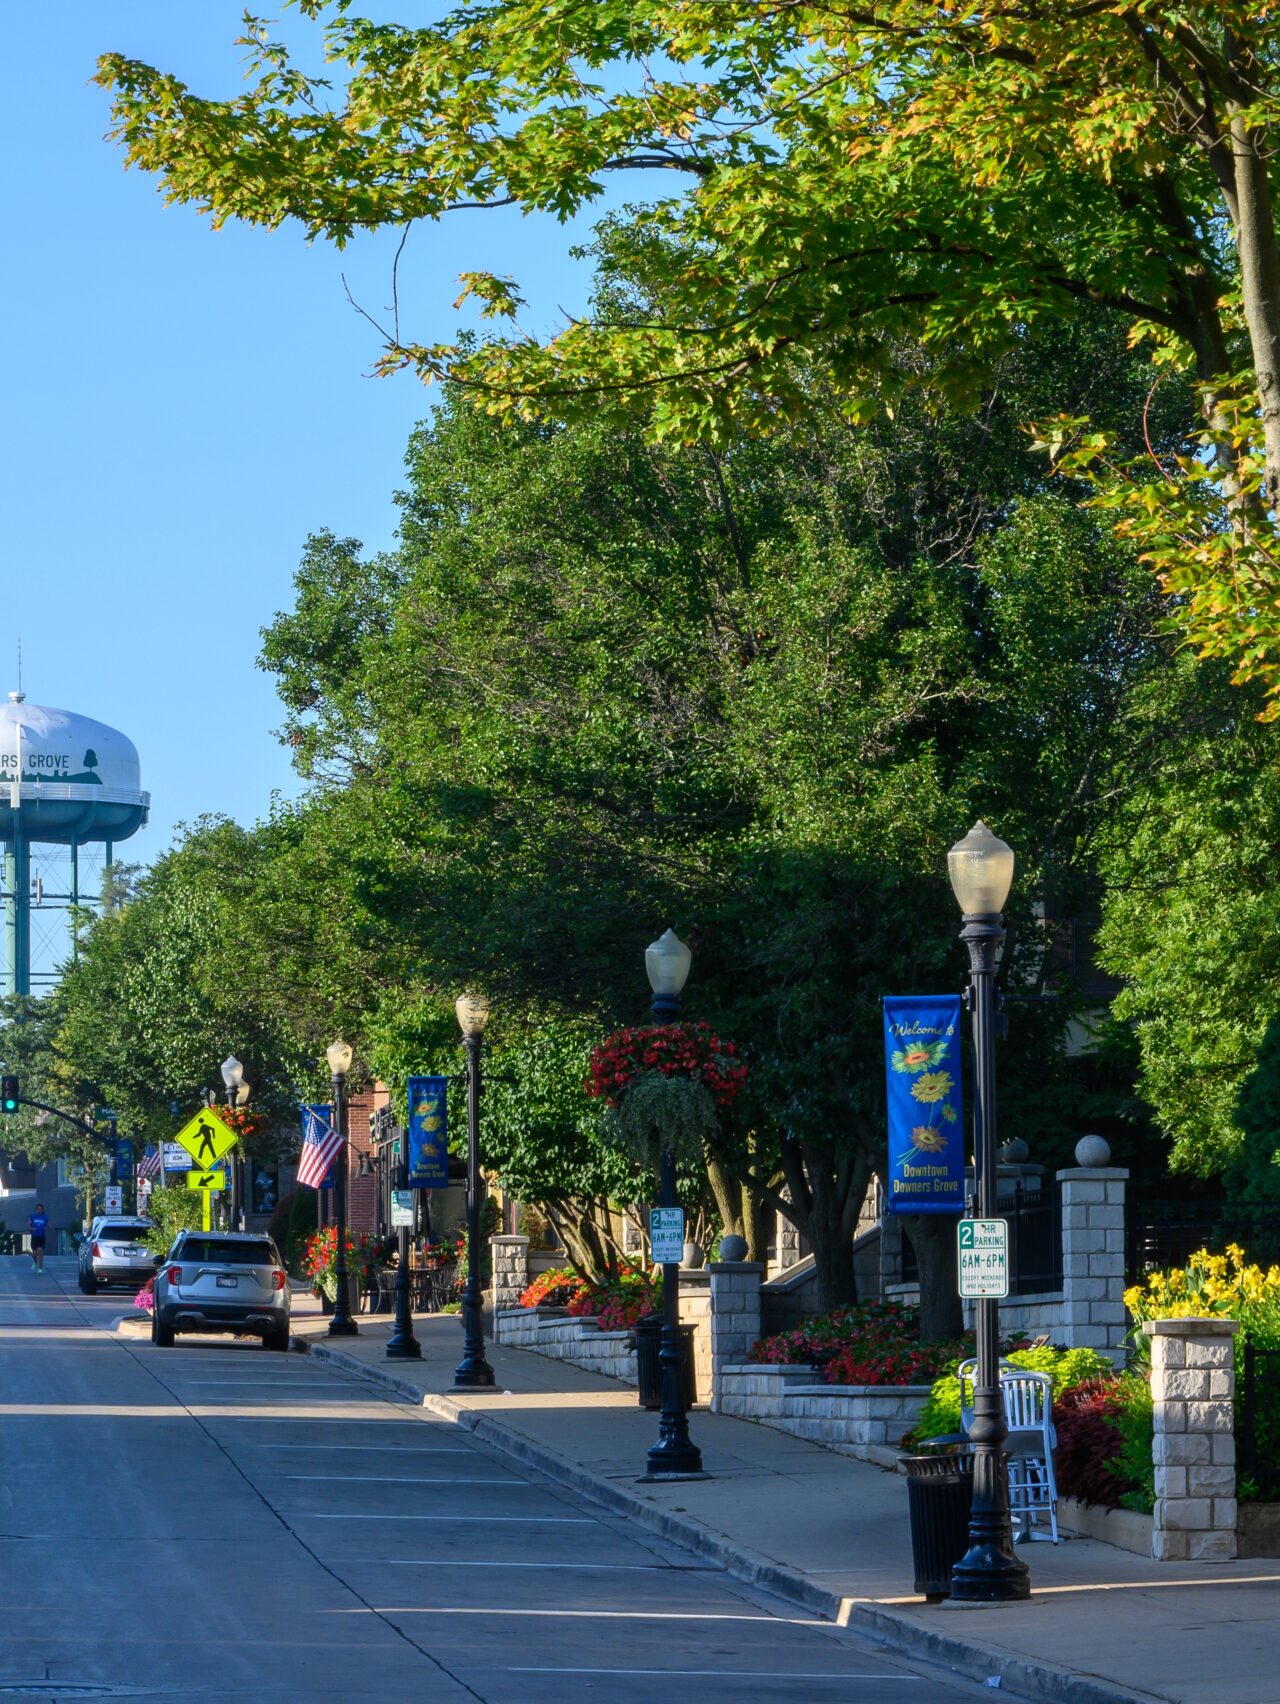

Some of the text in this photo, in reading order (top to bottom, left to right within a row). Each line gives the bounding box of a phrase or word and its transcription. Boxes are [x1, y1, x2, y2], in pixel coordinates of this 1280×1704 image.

[28, 754, 70, 768] GROVE
[888, 1020, 955, 1037] Welcome to
[903, 1163, 948, 1178] Downtown
[893, 1178, 958, 1193] Downers Grove
[652, 1213, 660, 1227] 2
[961, 1224, 996, 1245] 2 HR
[974, 1236, 1004, 1246] PARKING
[962, 1254, 1005, 1268] 6AM-6PM
